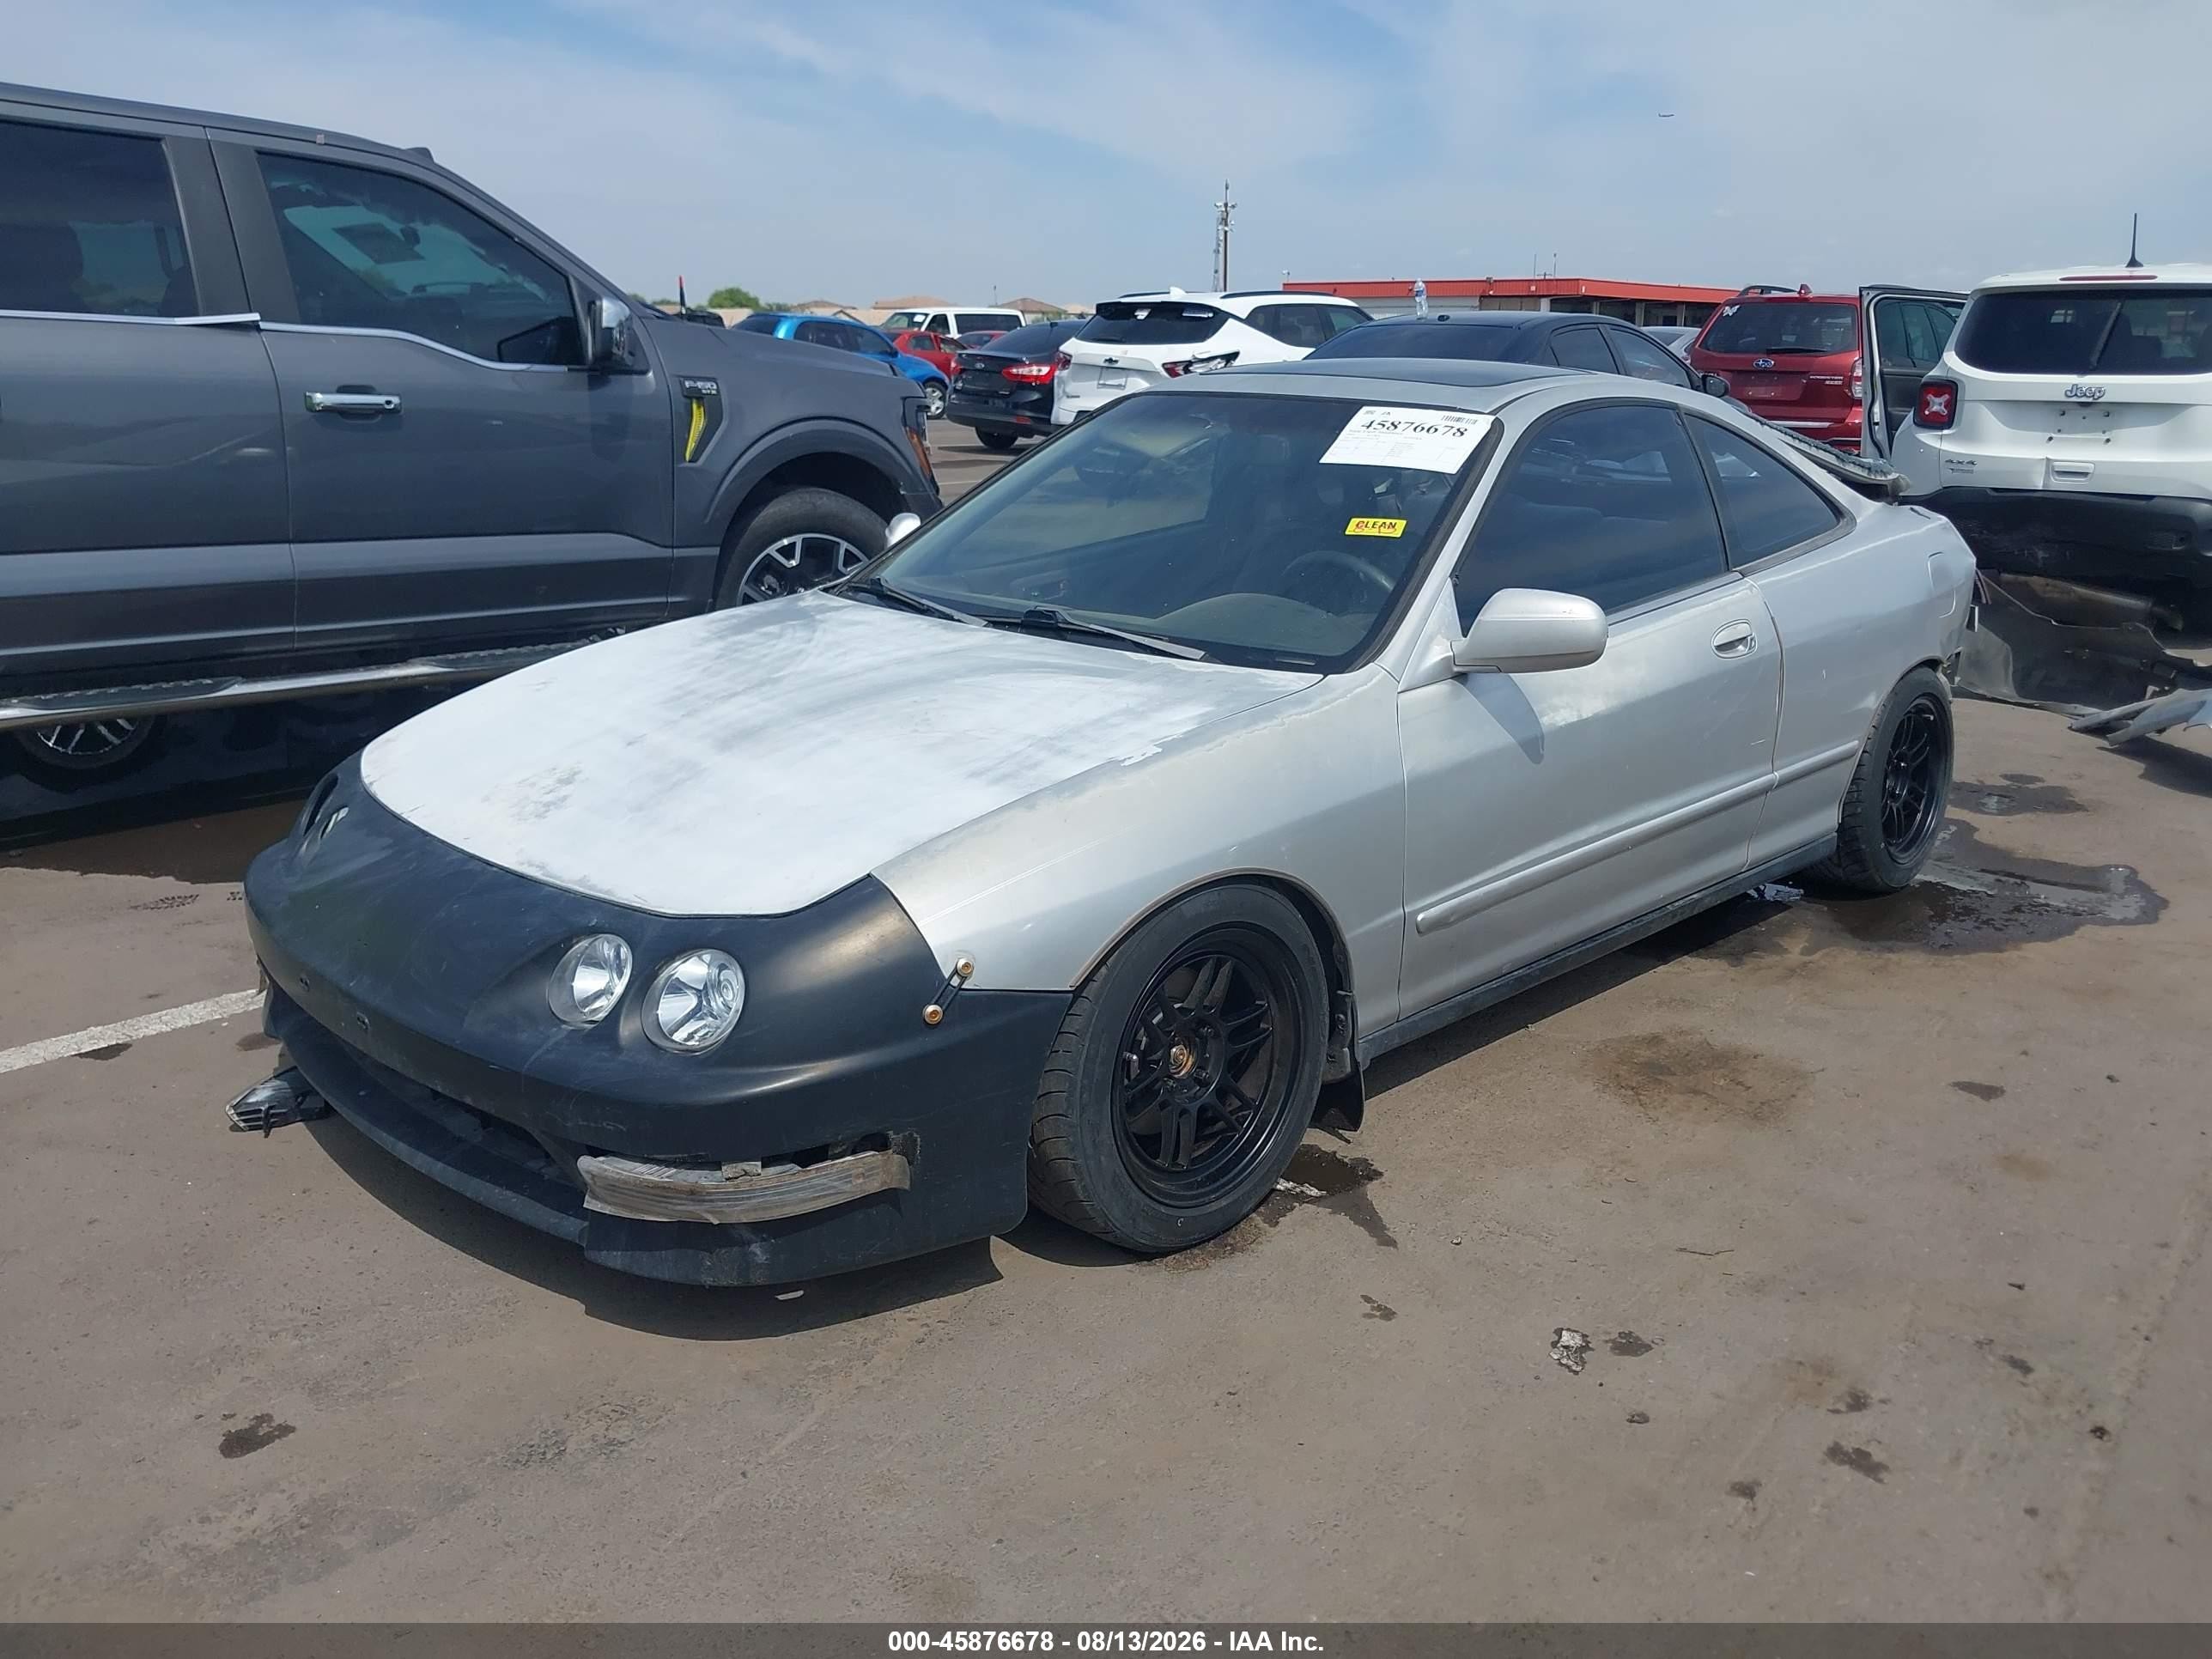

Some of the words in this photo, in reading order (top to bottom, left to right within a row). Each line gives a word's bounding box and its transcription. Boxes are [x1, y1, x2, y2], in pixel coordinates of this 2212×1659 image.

[2064, 384, 2106, 400] Jeep
[1360, 419, 1468, 438] 45876678
[1355, 520, 1398, 530] CLEAN
